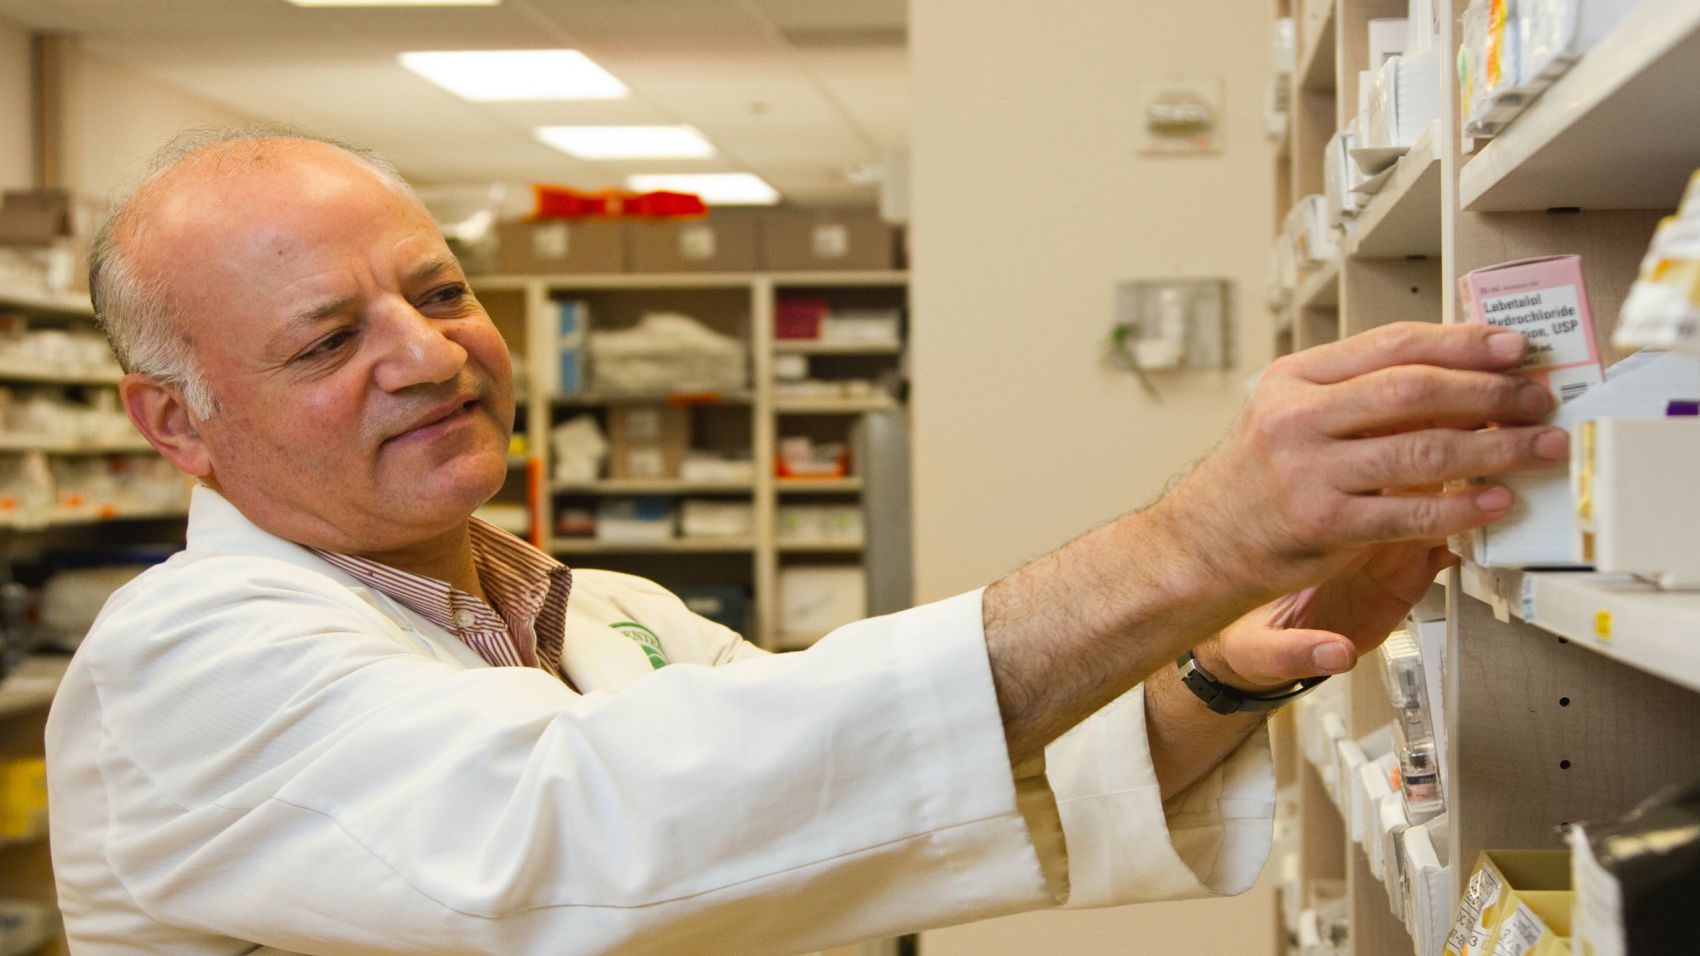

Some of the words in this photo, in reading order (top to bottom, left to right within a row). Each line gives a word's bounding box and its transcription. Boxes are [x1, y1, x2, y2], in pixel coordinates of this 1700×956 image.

[1483, 293, 1542, 313] Labetalol
[1487, 305, 1575, 326] Hydrochloride
[1551, 319, 1579, 335] USP
